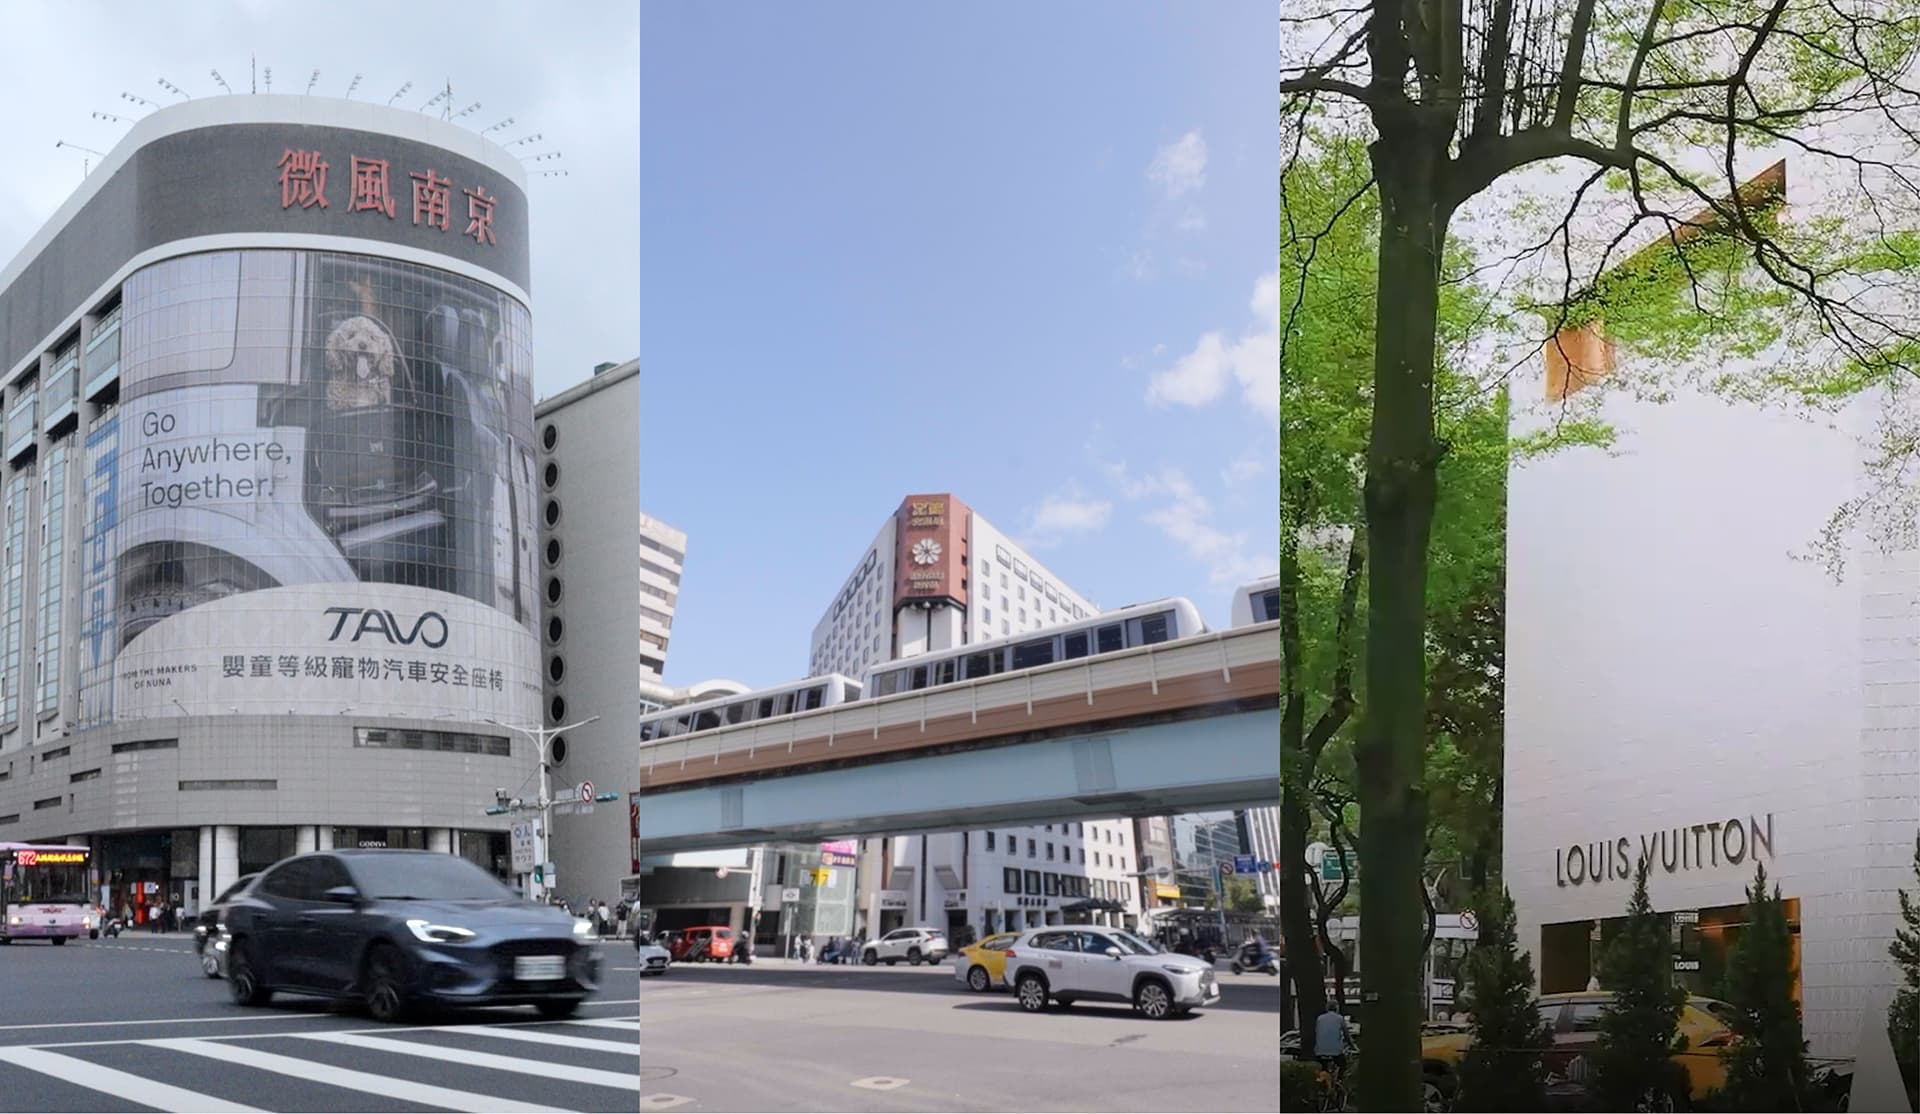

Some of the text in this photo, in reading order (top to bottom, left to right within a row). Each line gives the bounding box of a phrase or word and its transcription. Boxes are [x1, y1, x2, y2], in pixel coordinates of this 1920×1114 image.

[278, 148, 497, 246] 微風南京
[142, 411, 176, 437] Go
[141, 437, 292, 473] Anywhere,
[141, 473, 273, 509] Together.
[323, 607, 448, 648] TAVO
[157, 664, 197, 674] MAKERS
[222, 654, 504, 692] 嬰童等級寵物汽車安全座椅
[18, 852, 36, 865] 672
[1556, 813, 1774, 887] LOUIS VUITTON
